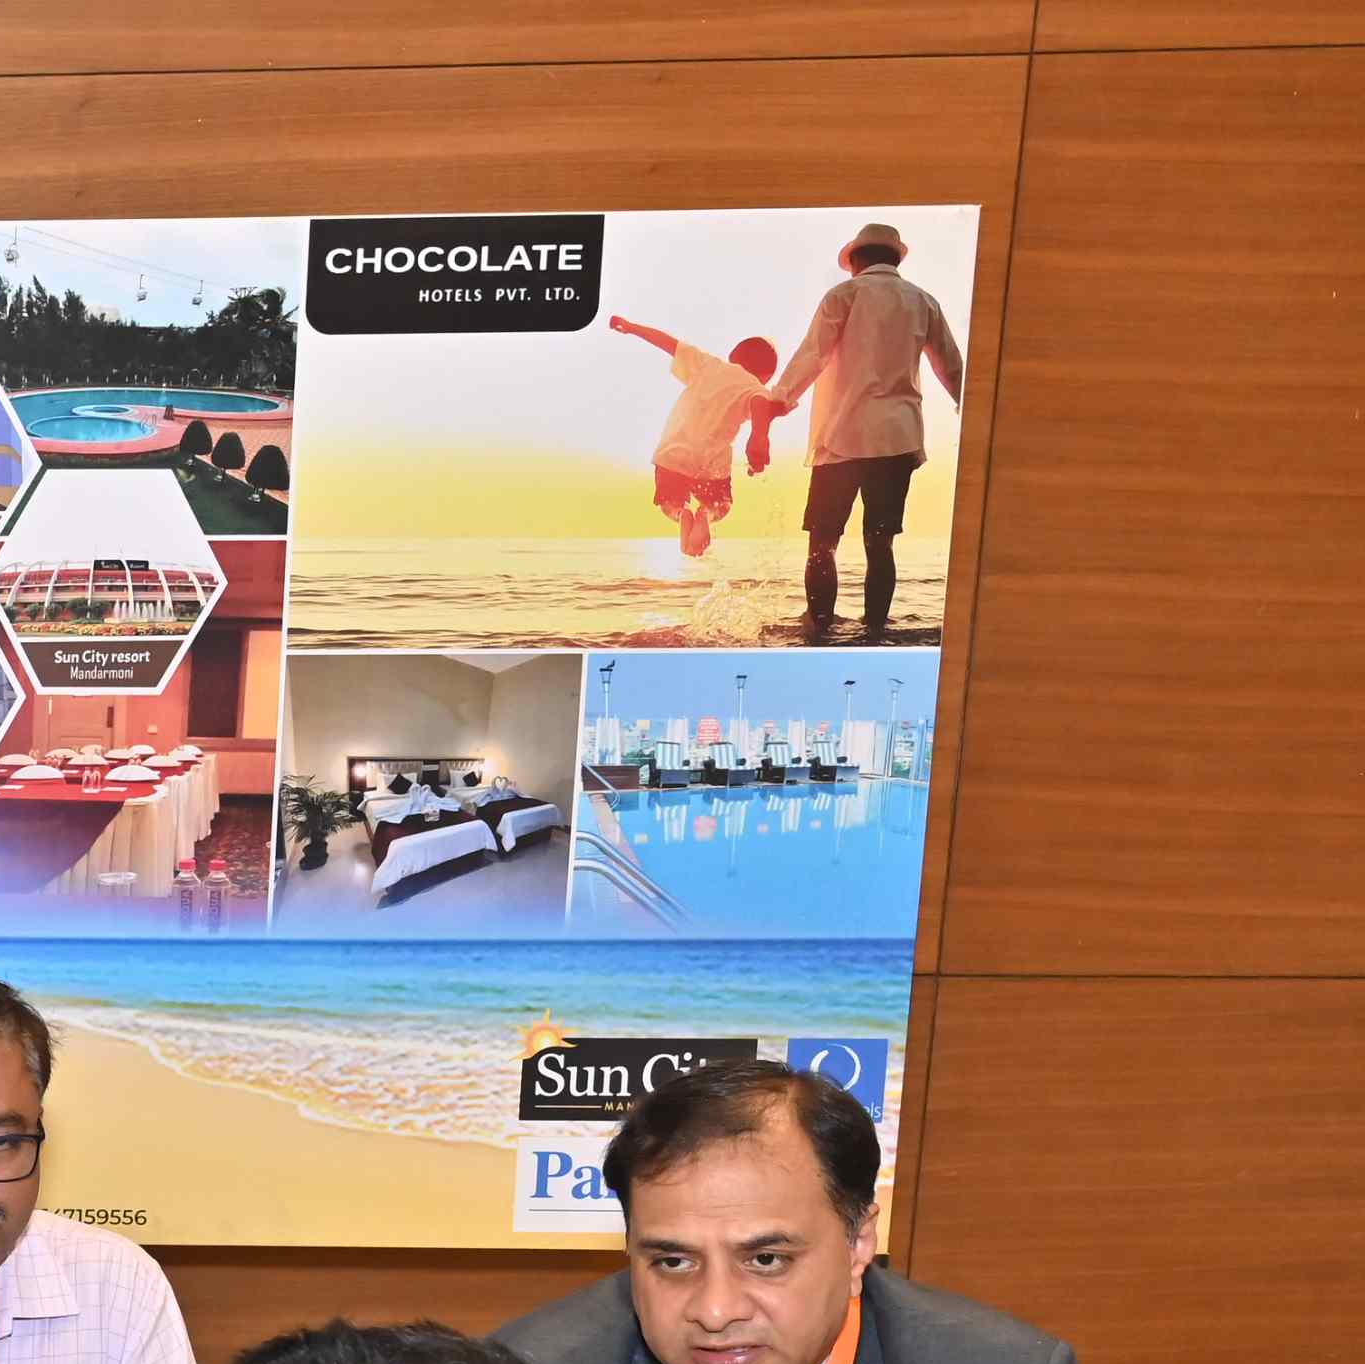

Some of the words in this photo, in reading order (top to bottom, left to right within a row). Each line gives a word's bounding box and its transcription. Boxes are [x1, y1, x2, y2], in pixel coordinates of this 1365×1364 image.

[325, 244, 583, 274] CHOCOLATE
[419, 288, 482, 303] HOTELS
[496, 287, 531, 301] PVT.
[545, 286, 580, 301] LTD.
[54, 651, 78, 664] Sun
[82, 650, 108, 666] City
[111, 650, 150, 663] resort
[70, 667, 133, 681] Mandarmoni
[534, 1053, 632, 1097] Sun
